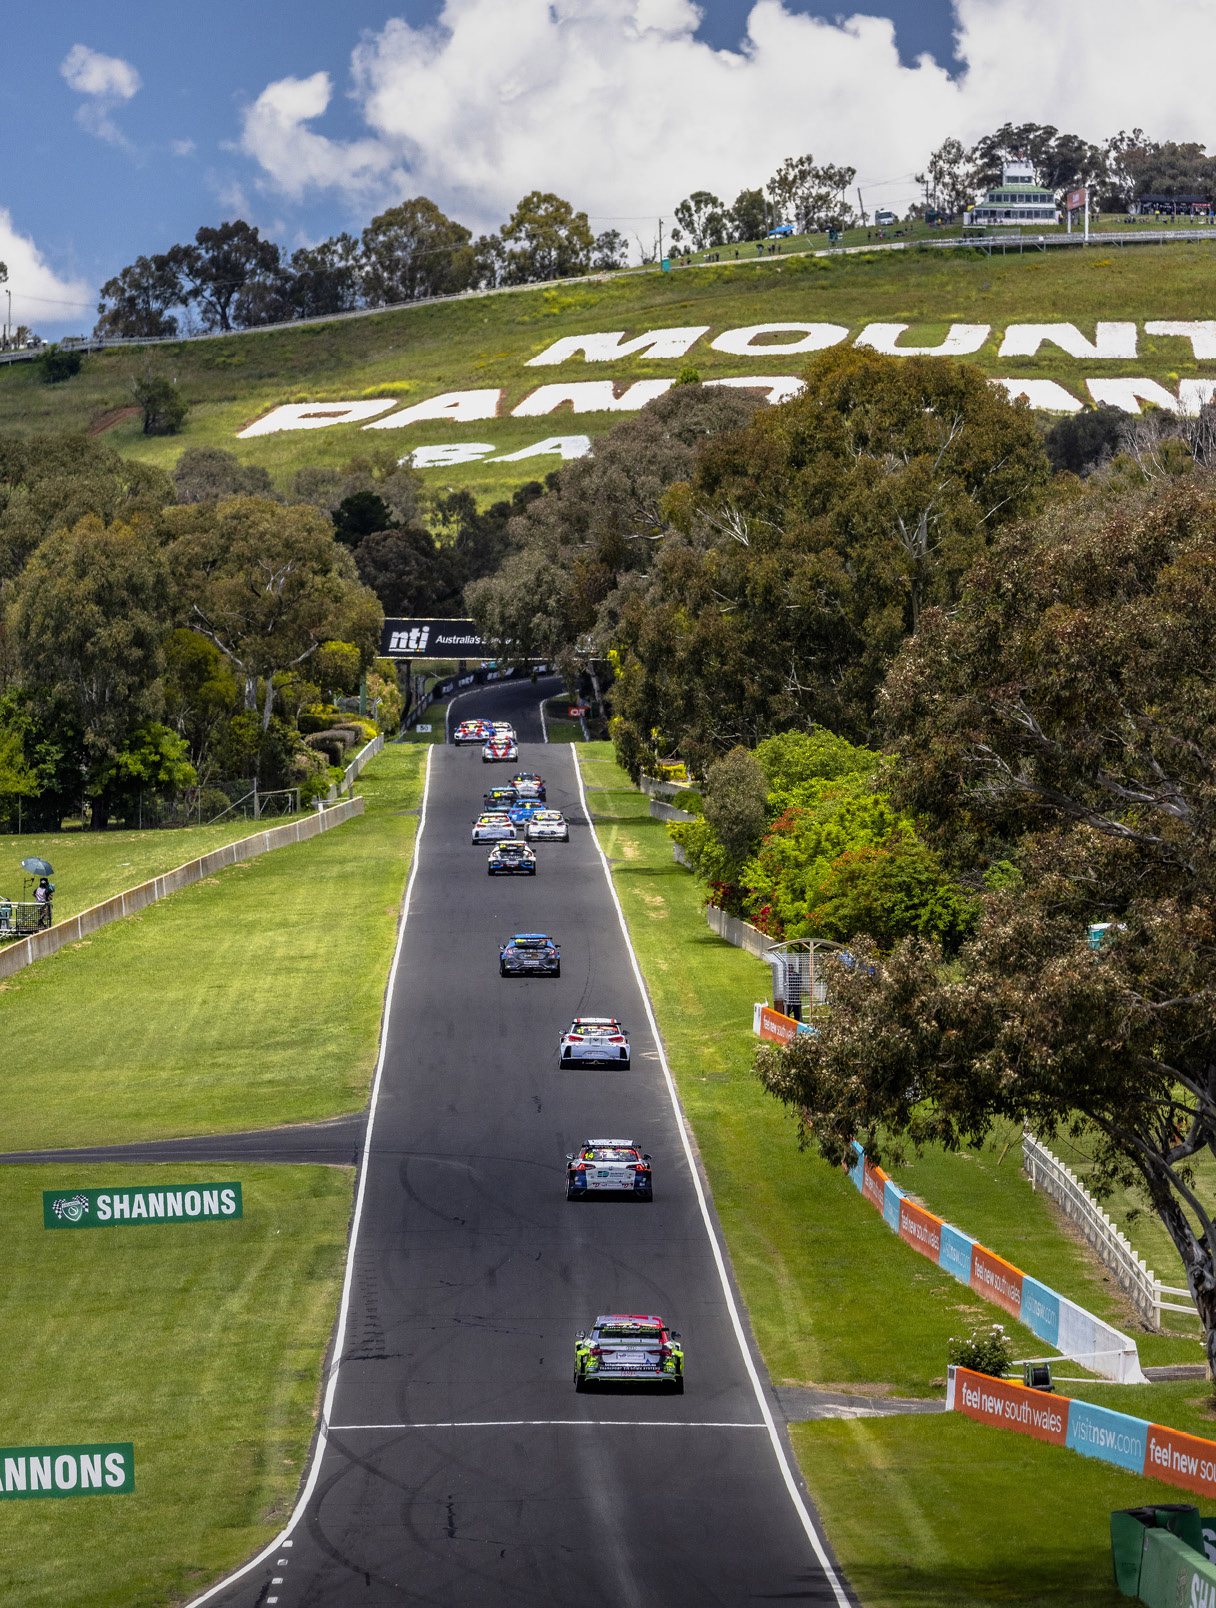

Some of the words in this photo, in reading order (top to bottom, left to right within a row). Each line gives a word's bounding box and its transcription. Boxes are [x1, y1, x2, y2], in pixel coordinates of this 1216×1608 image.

[389, 625, 431, 649] nti
[435, 635, 481, 644] Australia's
[97, 1189, 236, 1220] SHANNONS
[901, 1209, 909, 1230] feel
[908, 1218, 916, 1237] new
[917, 1223, 928, 1243] south
[928, 1229, 940, 1251] wales
[974, 1256, 985, 1280] feel
[984, 1267, 995, 1287] new
[994, 1273, 1008, 1295] south
[1007, 1281, 1021, 1305] wales
[962, 1382, 981, 1408] feel
[981, 1393, 1004, 1415] new
[1004, 1399, 1032, 1424] south
[1032, 1407, 1062, 1433] wales
[1071, 1415, 1142, 1458] visitnsw.com
[1149, 1437, 1172, 1468] feel
[1173, 1451, 1199, 1476] new
[0, 1453, 126, 1491] NNONS
